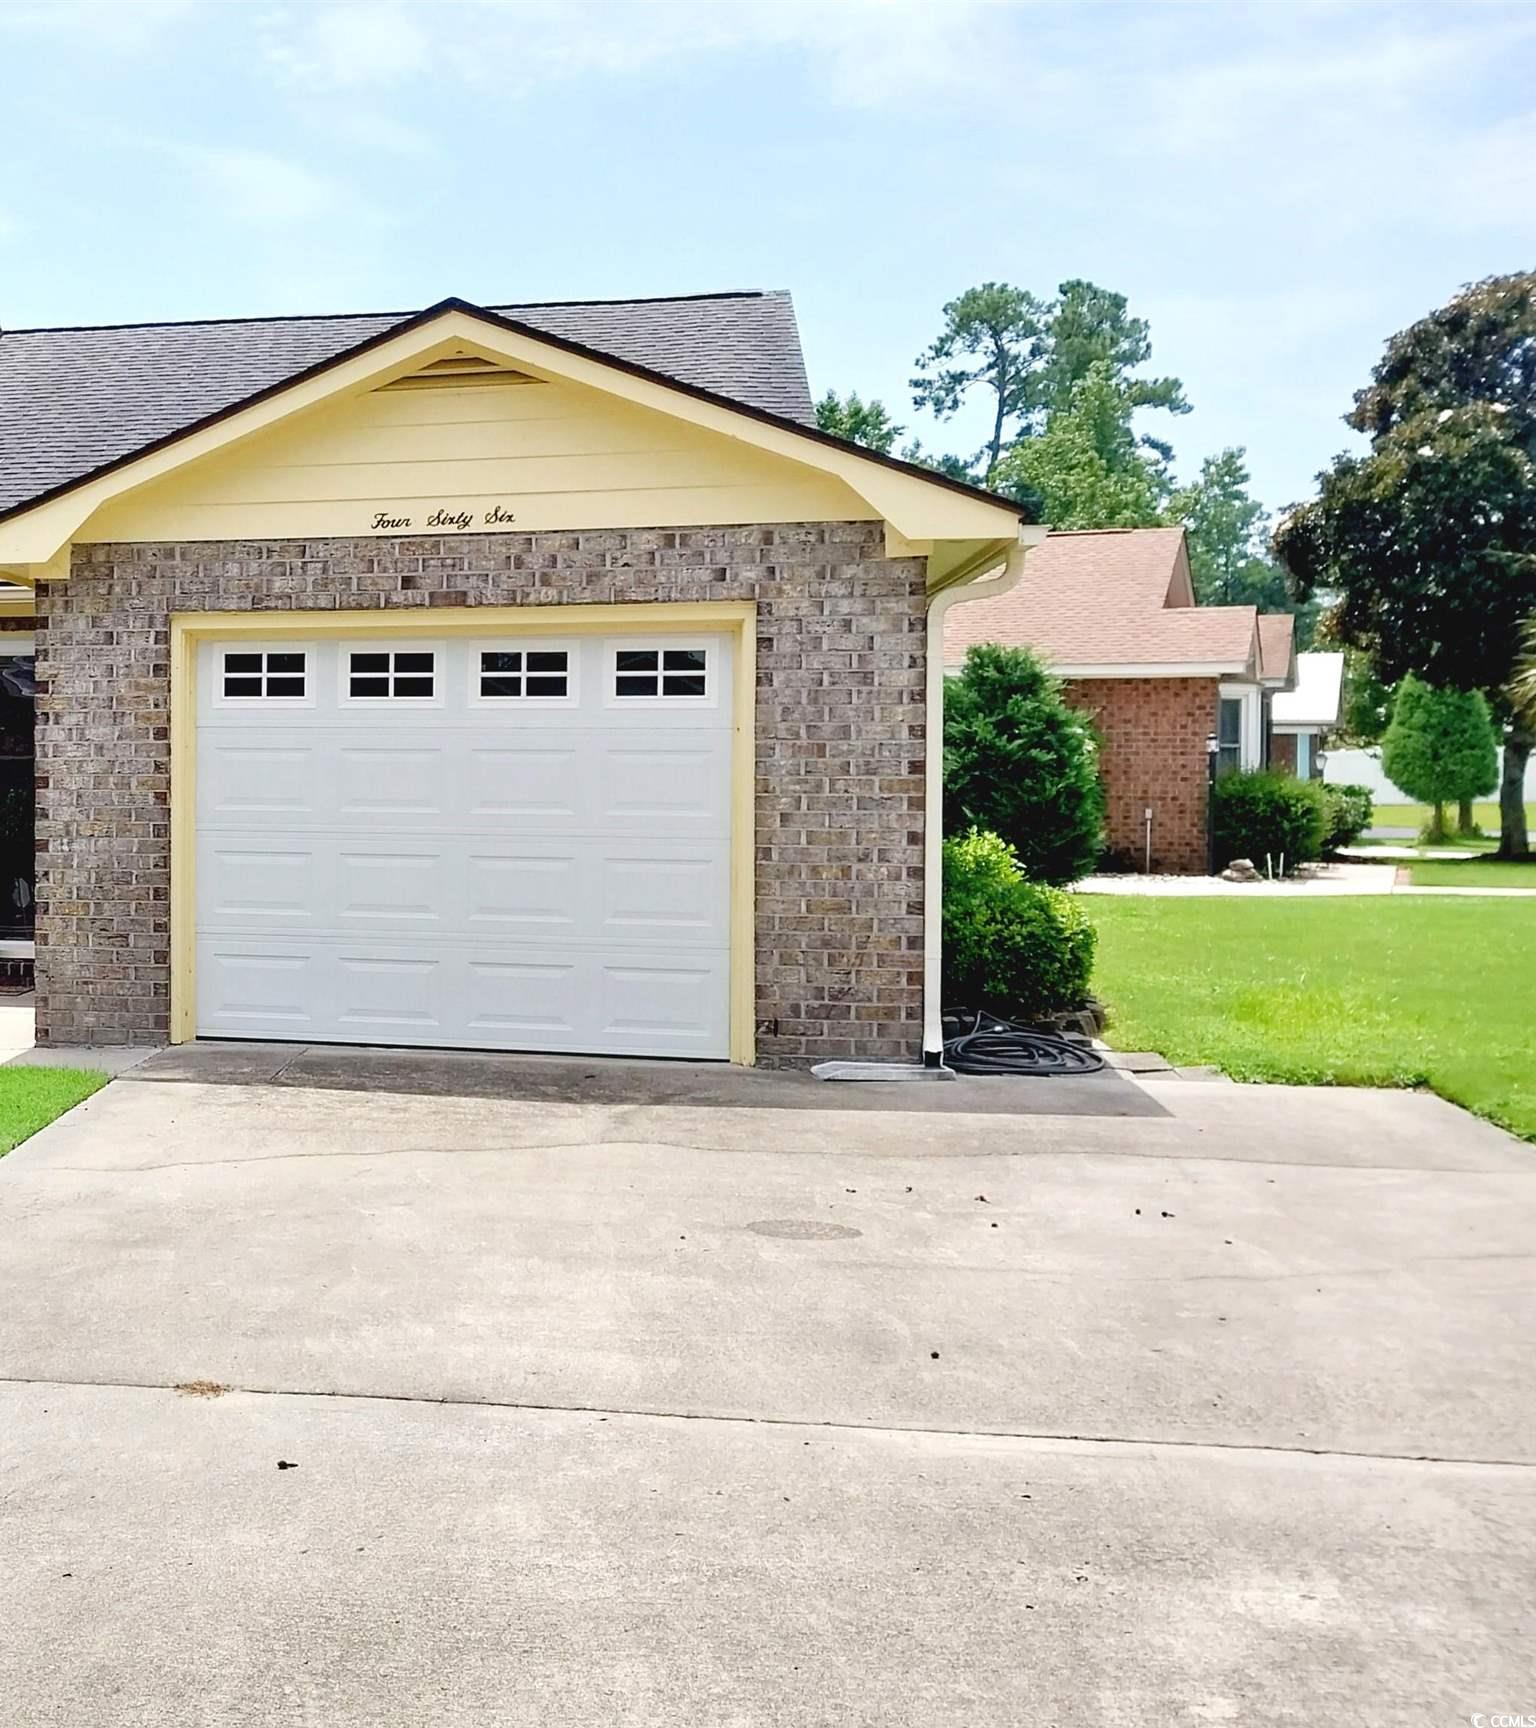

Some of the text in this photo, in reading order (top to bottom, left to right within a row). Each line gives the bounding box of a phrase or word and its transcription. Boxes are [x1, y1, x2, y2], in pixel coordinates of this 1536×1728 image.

[371, 505, 515, 530] Four Sixty Six
